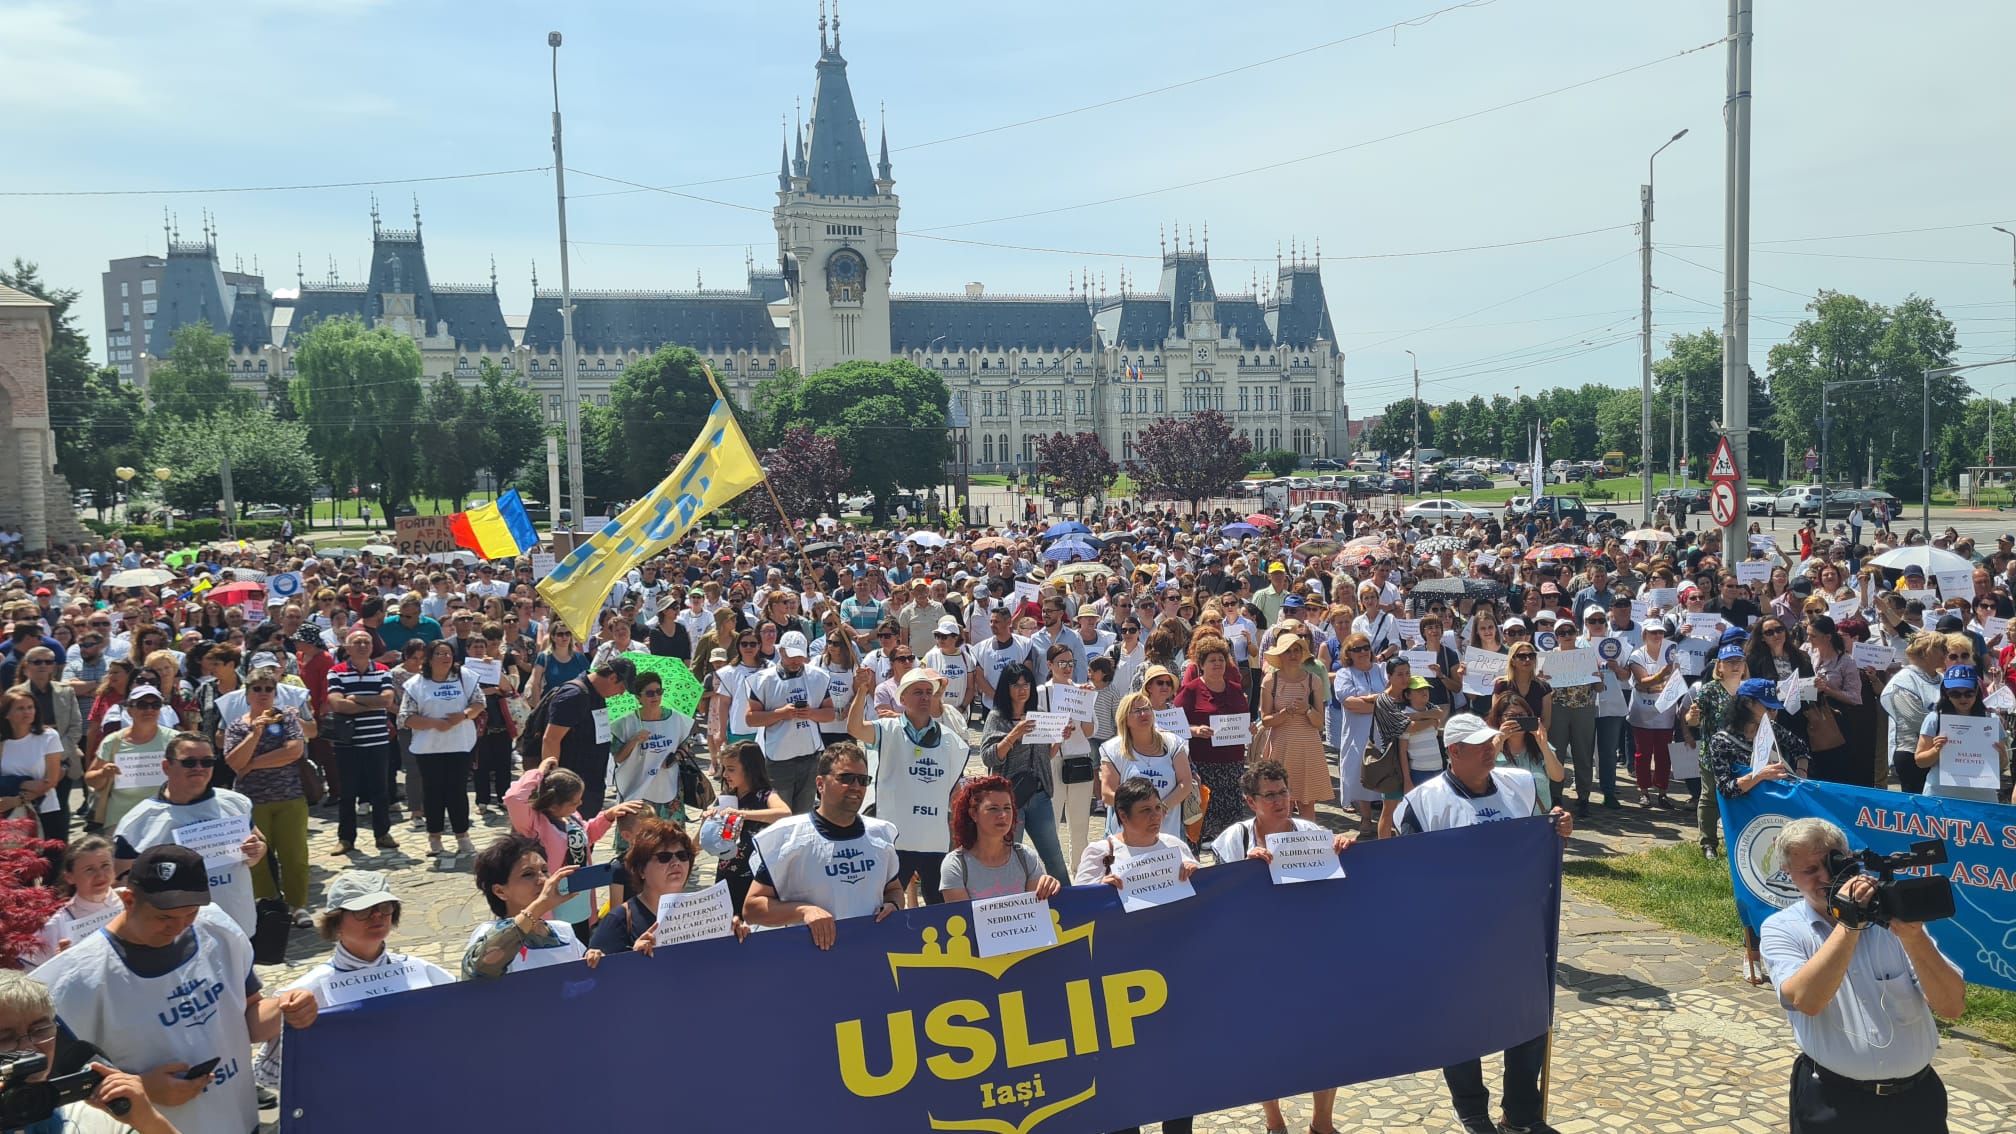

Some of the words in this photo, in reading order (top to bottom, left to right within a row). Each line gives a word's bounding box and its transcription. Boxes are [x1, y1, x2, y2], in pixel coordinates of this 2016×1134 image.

[1764, 687, 1776, 697] FS
[641, 739, 673, 750] USLIP
[909, 766, 944, 778] USLIP
[912, 805, 938, 817] FSLI
[2002, 825, 2016, 849] S
[825, 859, 875, 877] USLIP
[209, 872, 232, 887] SLI
[1949, 861, 2016, 892] ASA
[987, 911, 1037, 925] NEDIDACTIC
[991, 925, 1038, 939] CONTEAZĂ!
[329, 975, 361, 990] DACĂ
[158, 982, 225, 1027] USLIP
[835, 969, 1169, 1097] USLIP
[980, 1073, 1046, 1108] Iași
